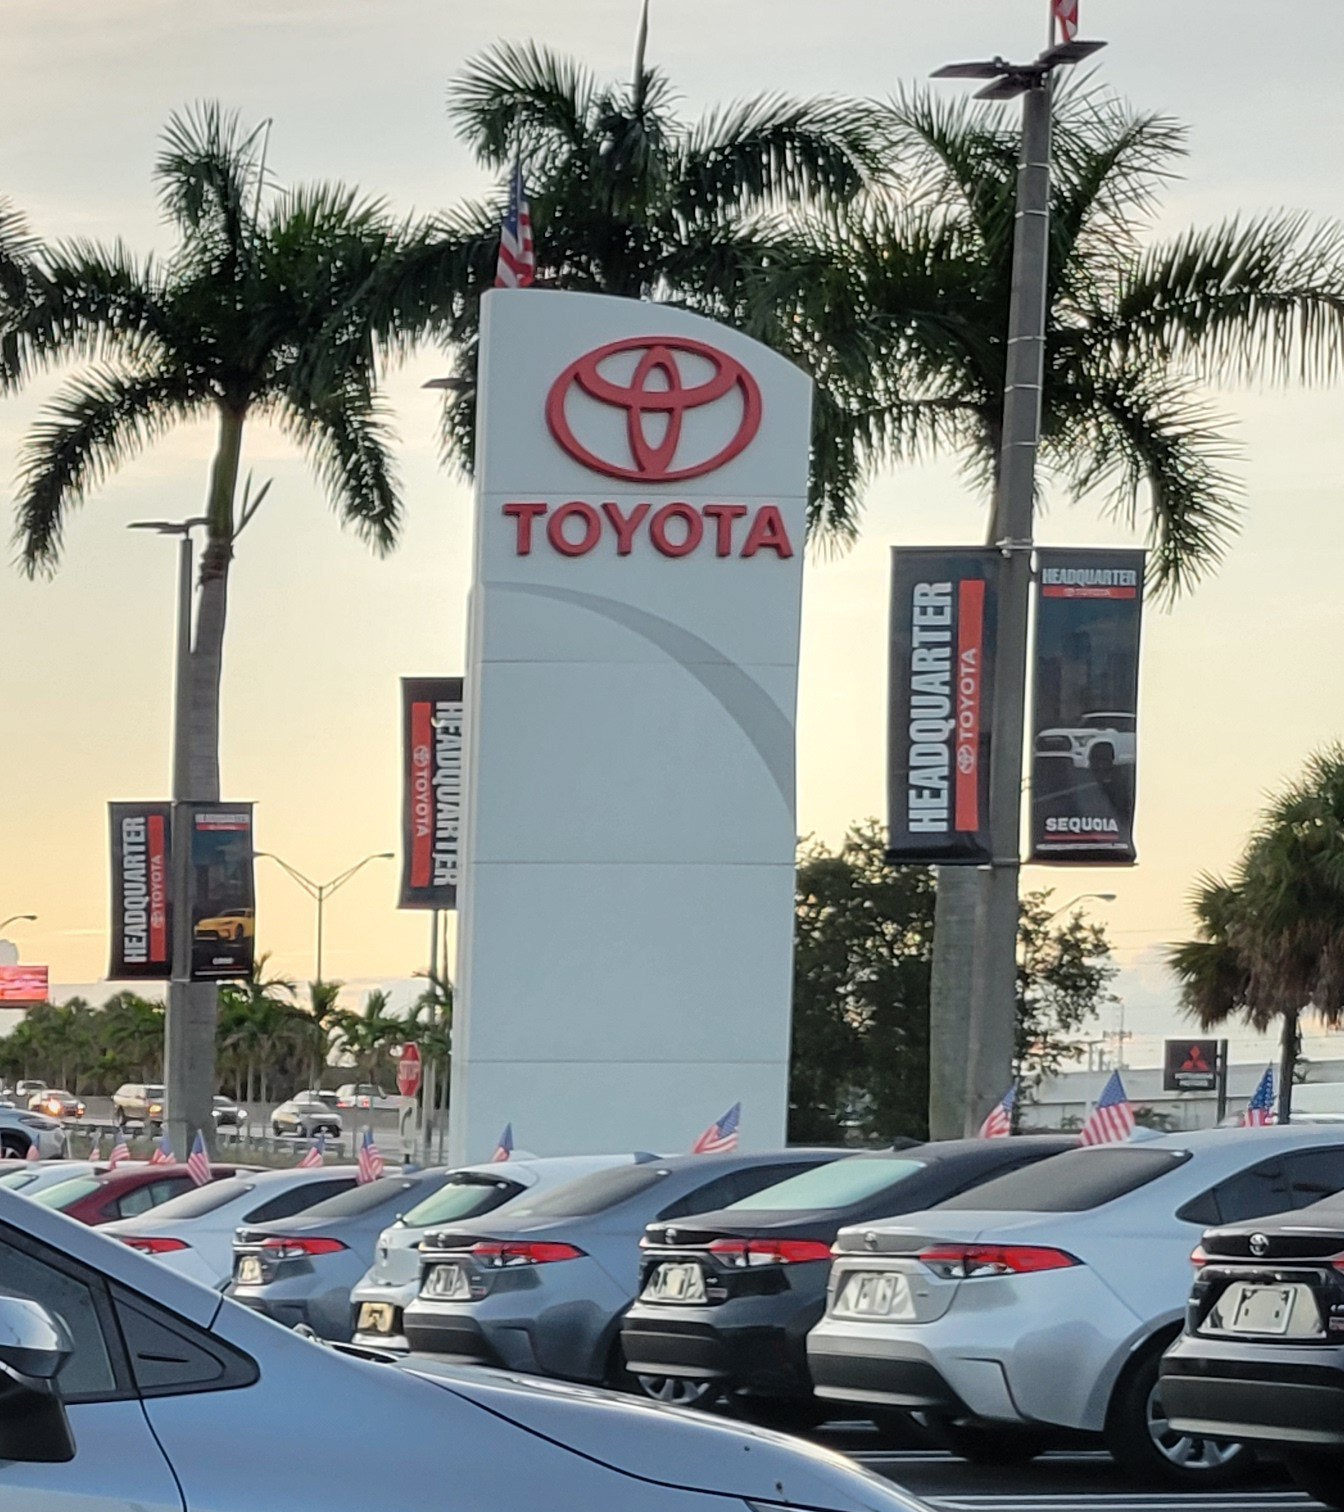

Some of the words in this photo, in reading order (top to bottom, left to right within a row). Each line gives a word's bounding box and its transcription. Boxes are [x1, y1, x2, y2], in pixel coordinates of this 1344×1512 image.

[503, 501, 794, 558] TOYOTA
[1042, 568, 1137, 587] HEADQUARTER
[908, 581, 956, 833] HEADQUARTER
[959, 648, 977, 740] TOYOTA
[414, 772, 429, 837] TOYOTA
[432, 701, 463, 887] HEADQUARTER
[1045, 817, 1119, 833] SEQUOIA
[122, 816, 150, 963] HEADQUARTER
[151, 855, 165, 909] TOYOTA
